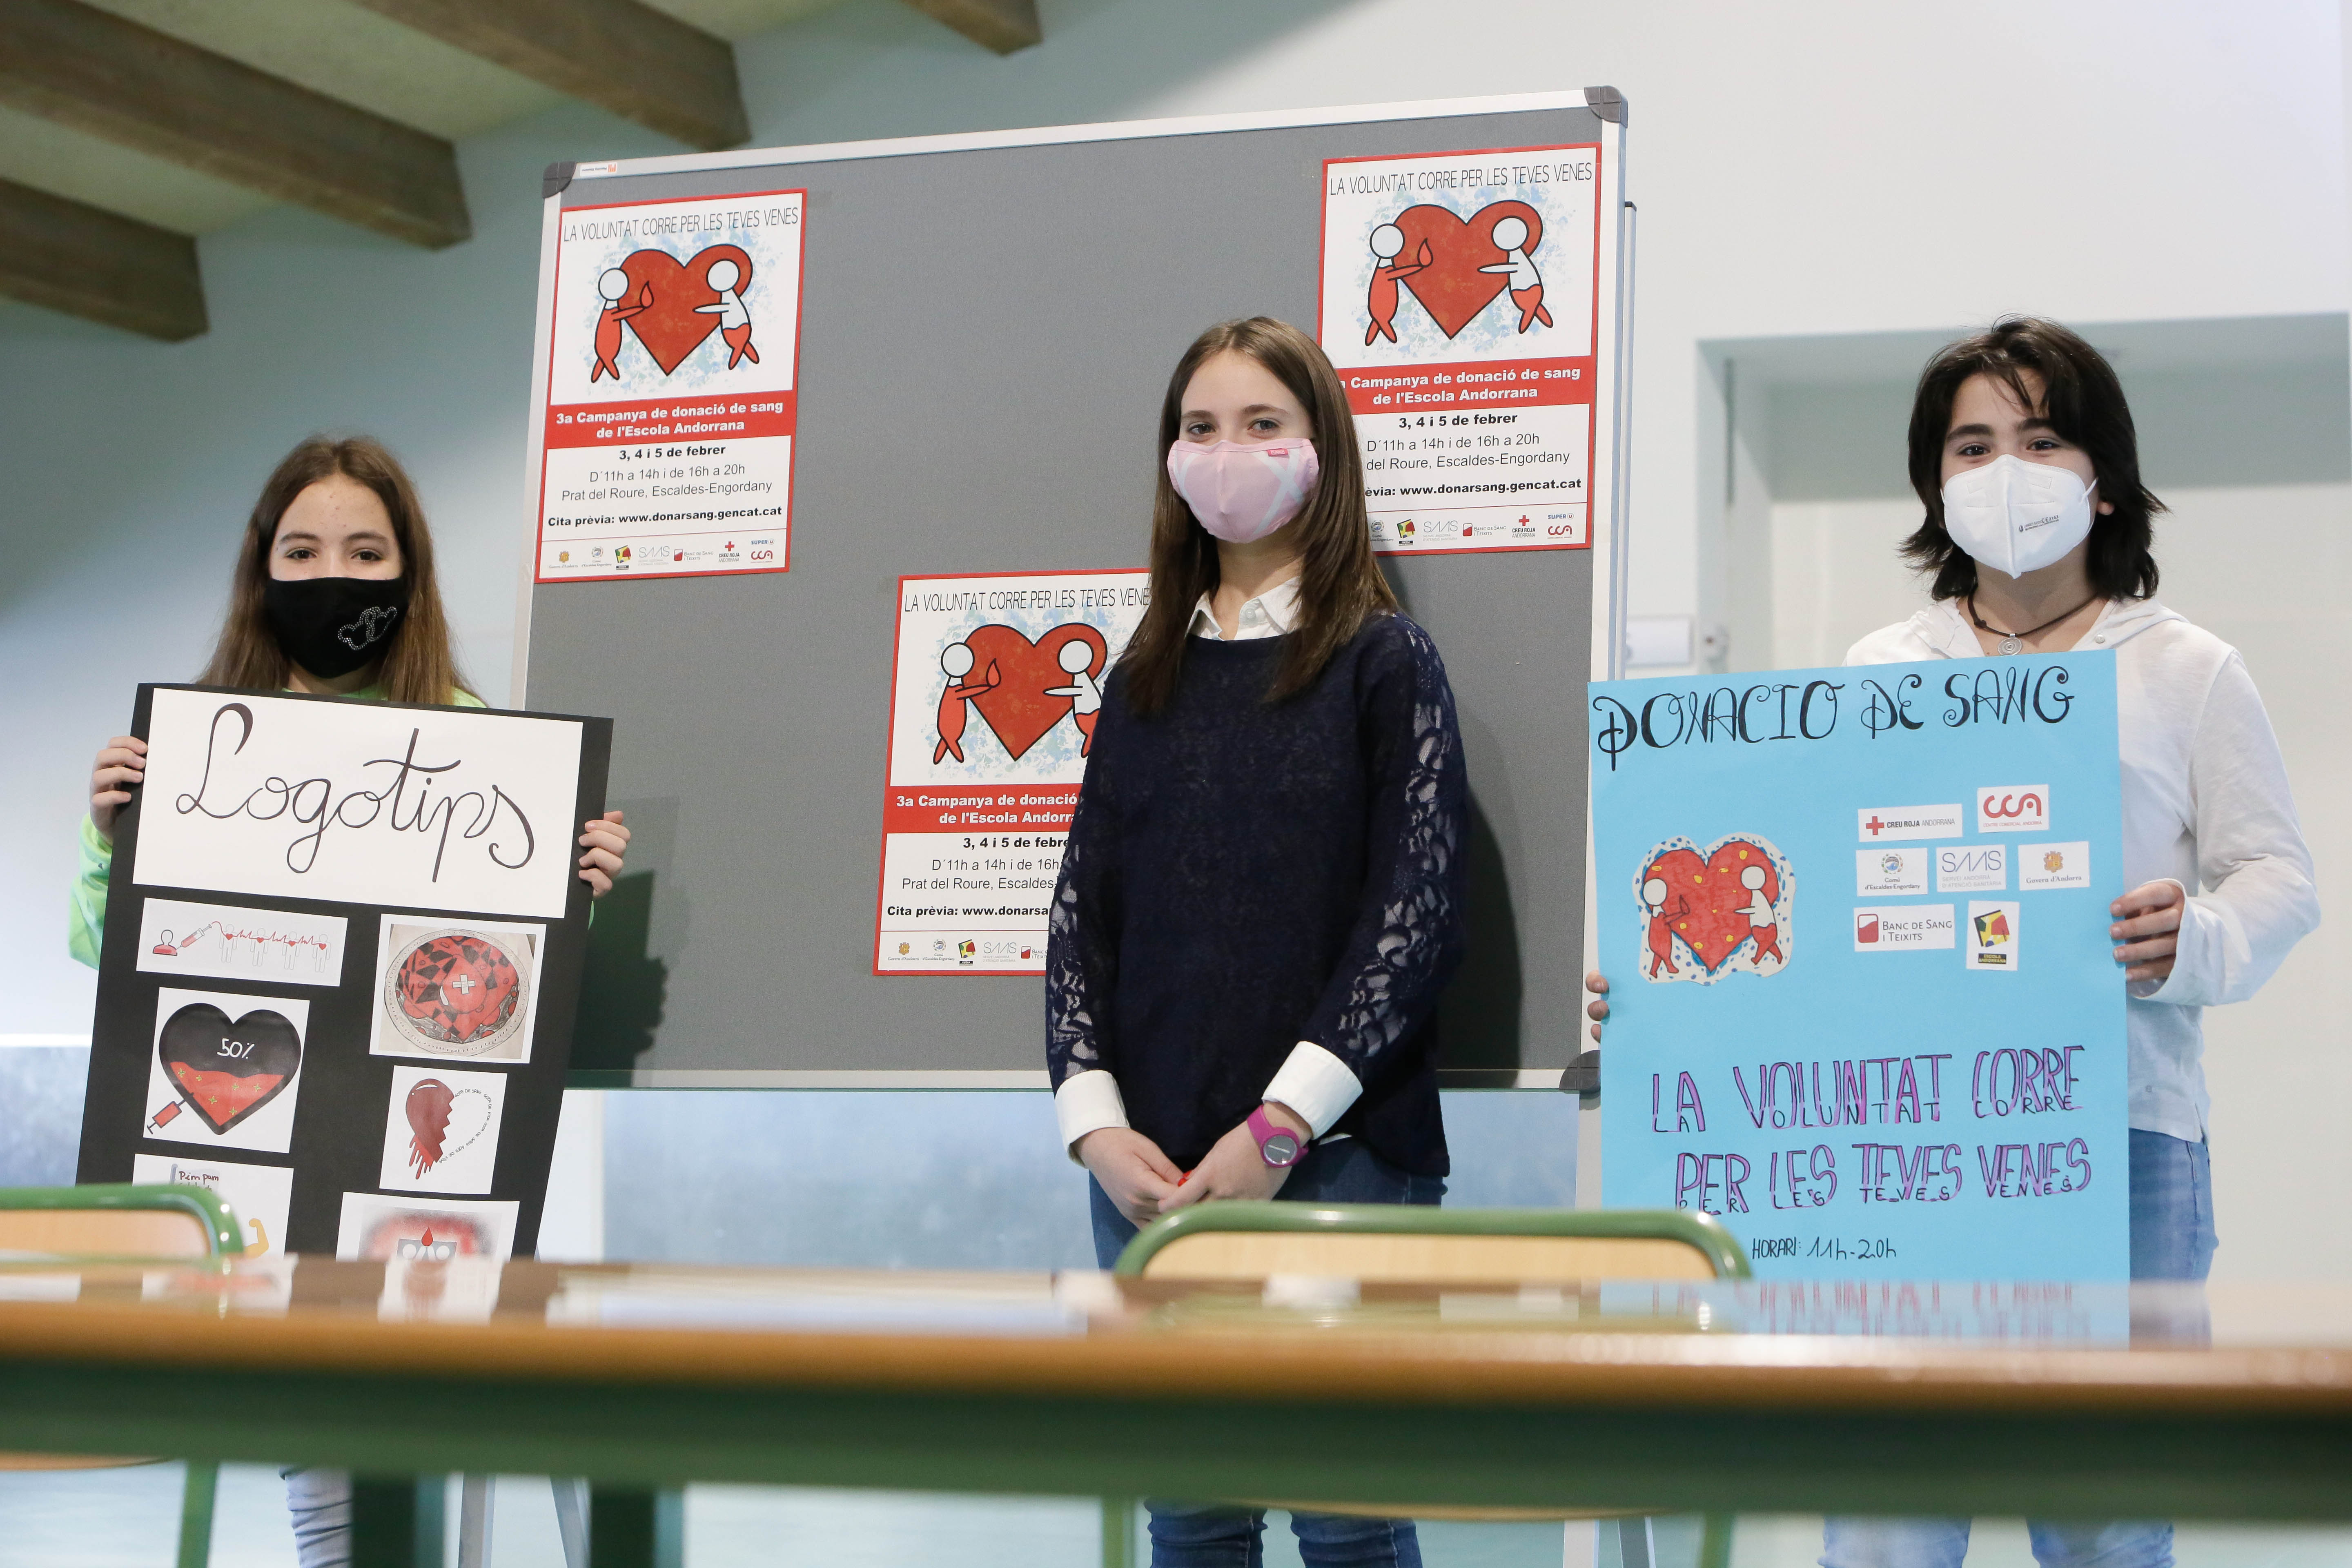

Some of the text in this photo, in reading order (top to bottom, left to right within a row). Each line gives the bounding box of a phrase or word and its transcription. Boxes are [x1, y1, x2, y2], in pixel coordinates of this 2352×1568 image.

[1330, 162, 1592, 195] LA VOLUNTAT CORRE PER LES TEVES VENES
[564, 207, 798, 242] LA VOLUNTAT CORRE PER LES TEVES VENES
[1351, 368, 1580, 390] Campanya de donació de sang
[1373, 388, 1537, 405] de l'Escola Andorrana
[556, 402, 783, 424] 3a Campanya de donació de sang
[596, 421, 744, 439] de l'Escola Andorrana
[1399, 414, 1518, 430] 3, 4 i 5 de febrer
[1409, 441, 1416, 450] a
[1422, 438, 1444, 449] 14h
[1449, 437, 1451, 448] i
[1456, 437, 1471, 448] de
[1477, 435, 1499, 447] 16h
[1504, 437, 1511, 445] a
[1516, 433, 1539, 445] 20h
[619, 445, 726, 461] 3, 4 i 5 de febrer
[1366, 451, 1570, 470] del Roure, Escaldes-Engordany
[639, 469, 659, 480] 14h
[664, 468, 666, 479] i
[670, 467, 684, 478] de
[689, 466, 709, 477] 16h
[713, 468, 719, 476] a
[724, 463, 745, 475] 20h
[562, 481, 772, 501] Prat del Roure, Escaldes-Engordany
[1365, 479, 1581, 496] èvia: www.donarsang.gencat.cat
[548, 506, 782, 527] Cita prèvia: www.donarsang.gencat.cat
[905, 587, 1149, 612] LA VOLUNTAT CORRE PER LES TEVES VENE
[1592, 666, 2074, 771] DONACIO DE SANG
[176, 702, 534, 882] Logotips
[896, 793, 1078, 808] 3a Campanya de donació
[939, 811, 1074, 824] de l'Escola Andorr
[963, 837, 1069, 850] 3, 4 i 5 de febre
[972, 862, 979, 870] a
[984, 859, 1006, 870] 14h
[1010, 859, 1013, 870] i
[1017, 859, 1032, 870] de
[1038, 858, 1059, 870] 16h
[902, 878, 993, 891] Prat del Roure,
[887, 906, 958, 918] Cita prèvia:
[1883, 921, 1908, 930] BANC
[1926, 920, 1952, 929] SANG
[1888, 932, 1922, 941] TEIXITS
[217, 1038, 254, 1059] 50%
[1652, 1045, 2085, 1133] LA VOLUNTAT CORRE
[179, 1171, 218, 1185] Pim pam
[1675, 1138, 2091, 1215] PER LES TEVES VENES
[1752, 1236, 1801, 1259] HORARI:
